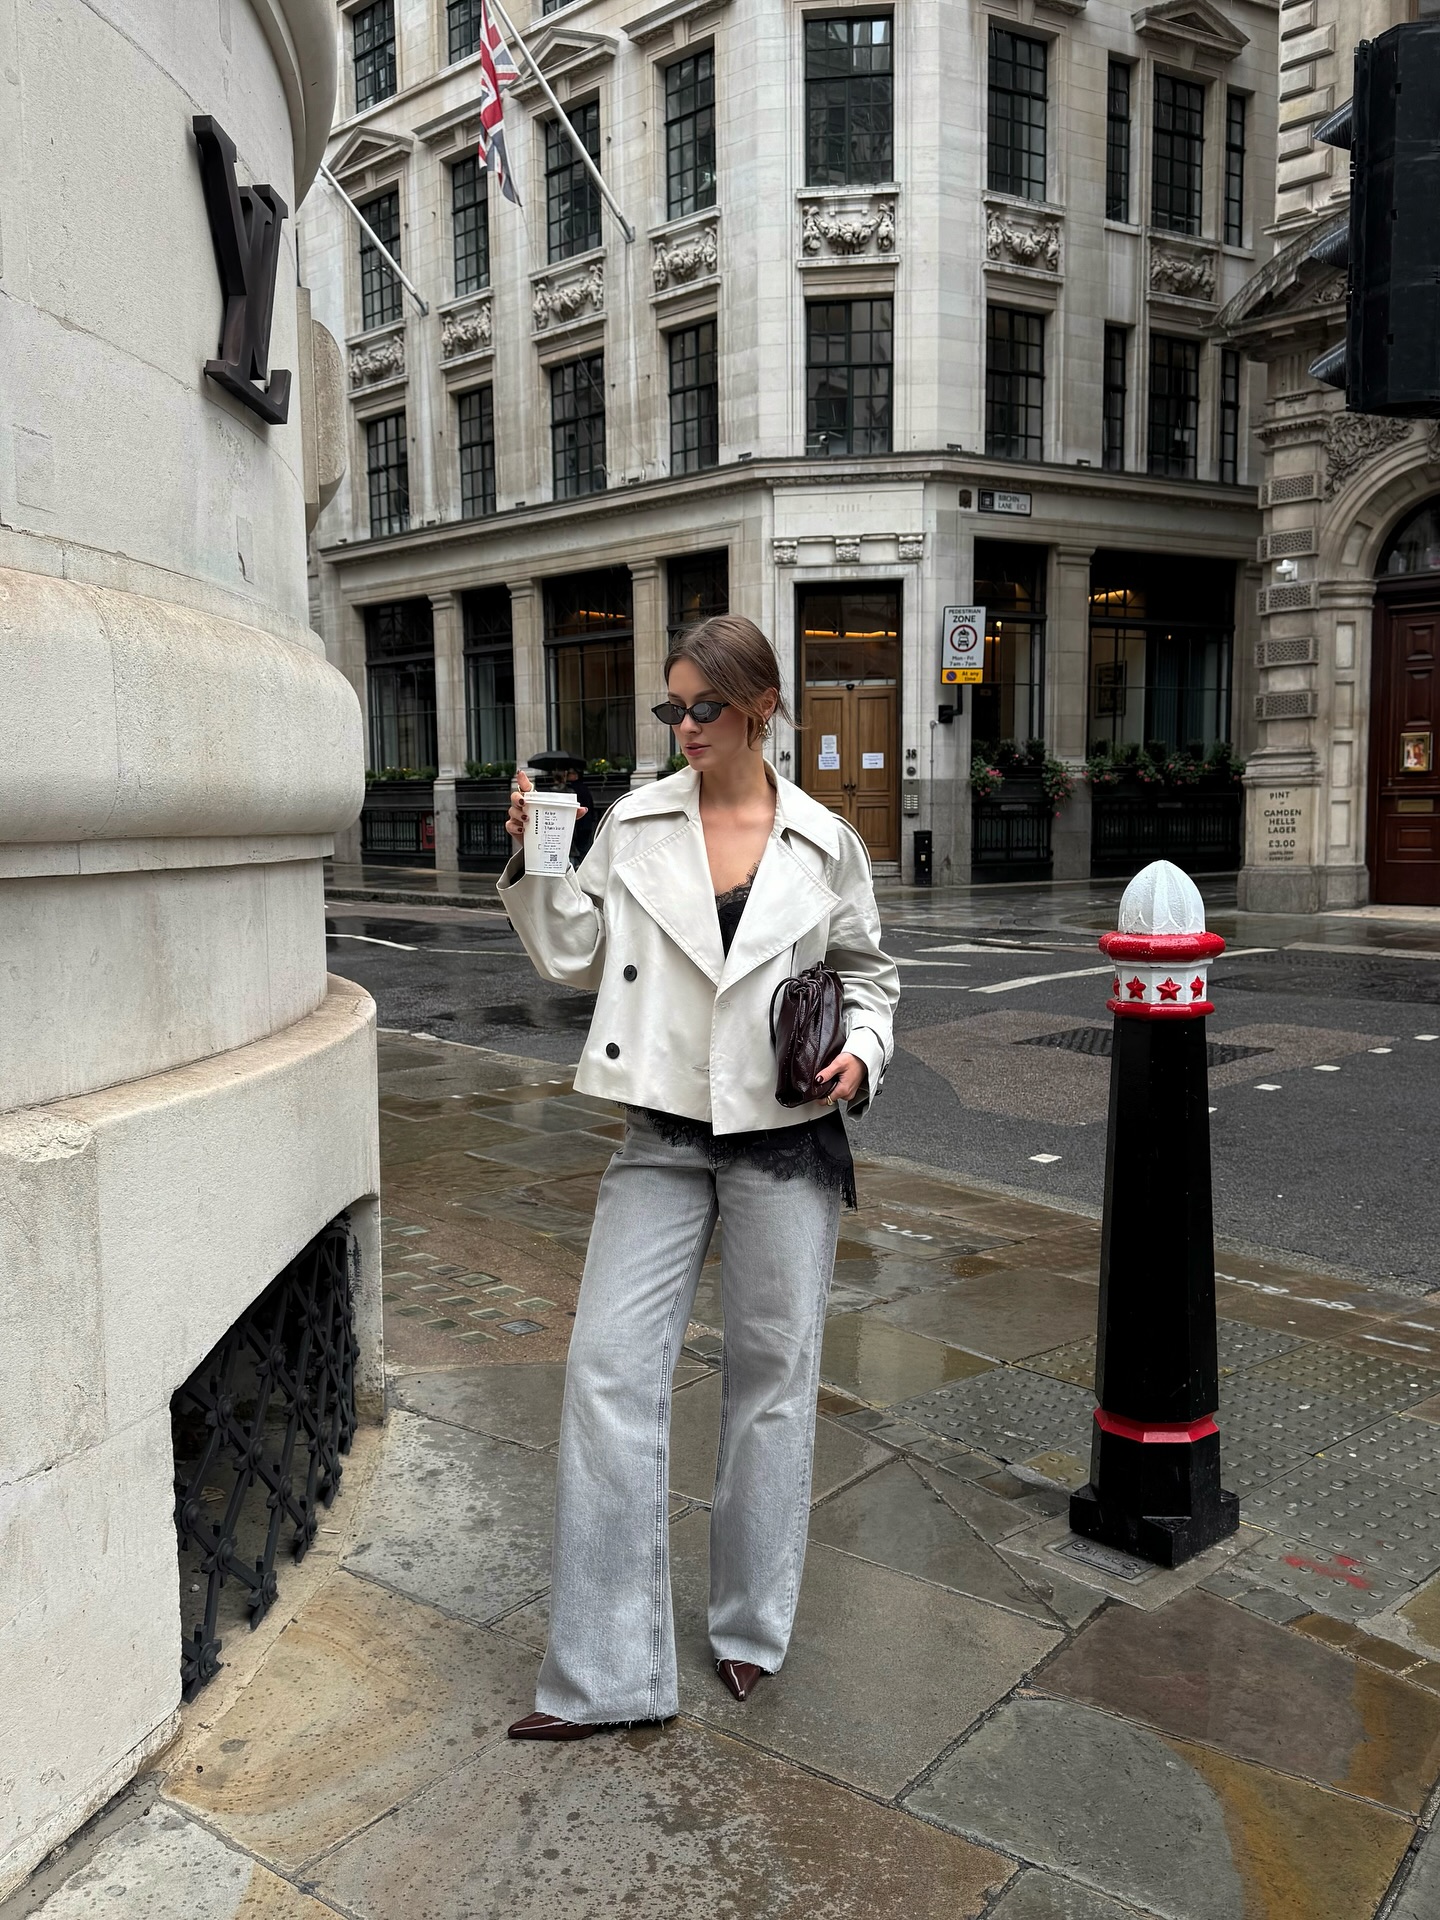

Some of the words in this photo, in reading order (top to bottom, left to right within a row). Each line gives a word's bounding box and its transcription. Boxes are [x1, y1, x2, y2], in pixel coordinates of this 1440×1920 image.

[998, 502, 1013, 510] LANE
[953, 615, 976, 623] ZONE
[779, 750, 791, 762] 36
[905, 748, 917, 760] 38
[1269, 791, 1290, 800] PINT
[1263, 809, 1302, 817] CAMDEN
[1268, 817, 1296, 825] HELLS
[1267, 826, 1297, 834] LAGER
[1268, 839, 1296, 848] £3.00
